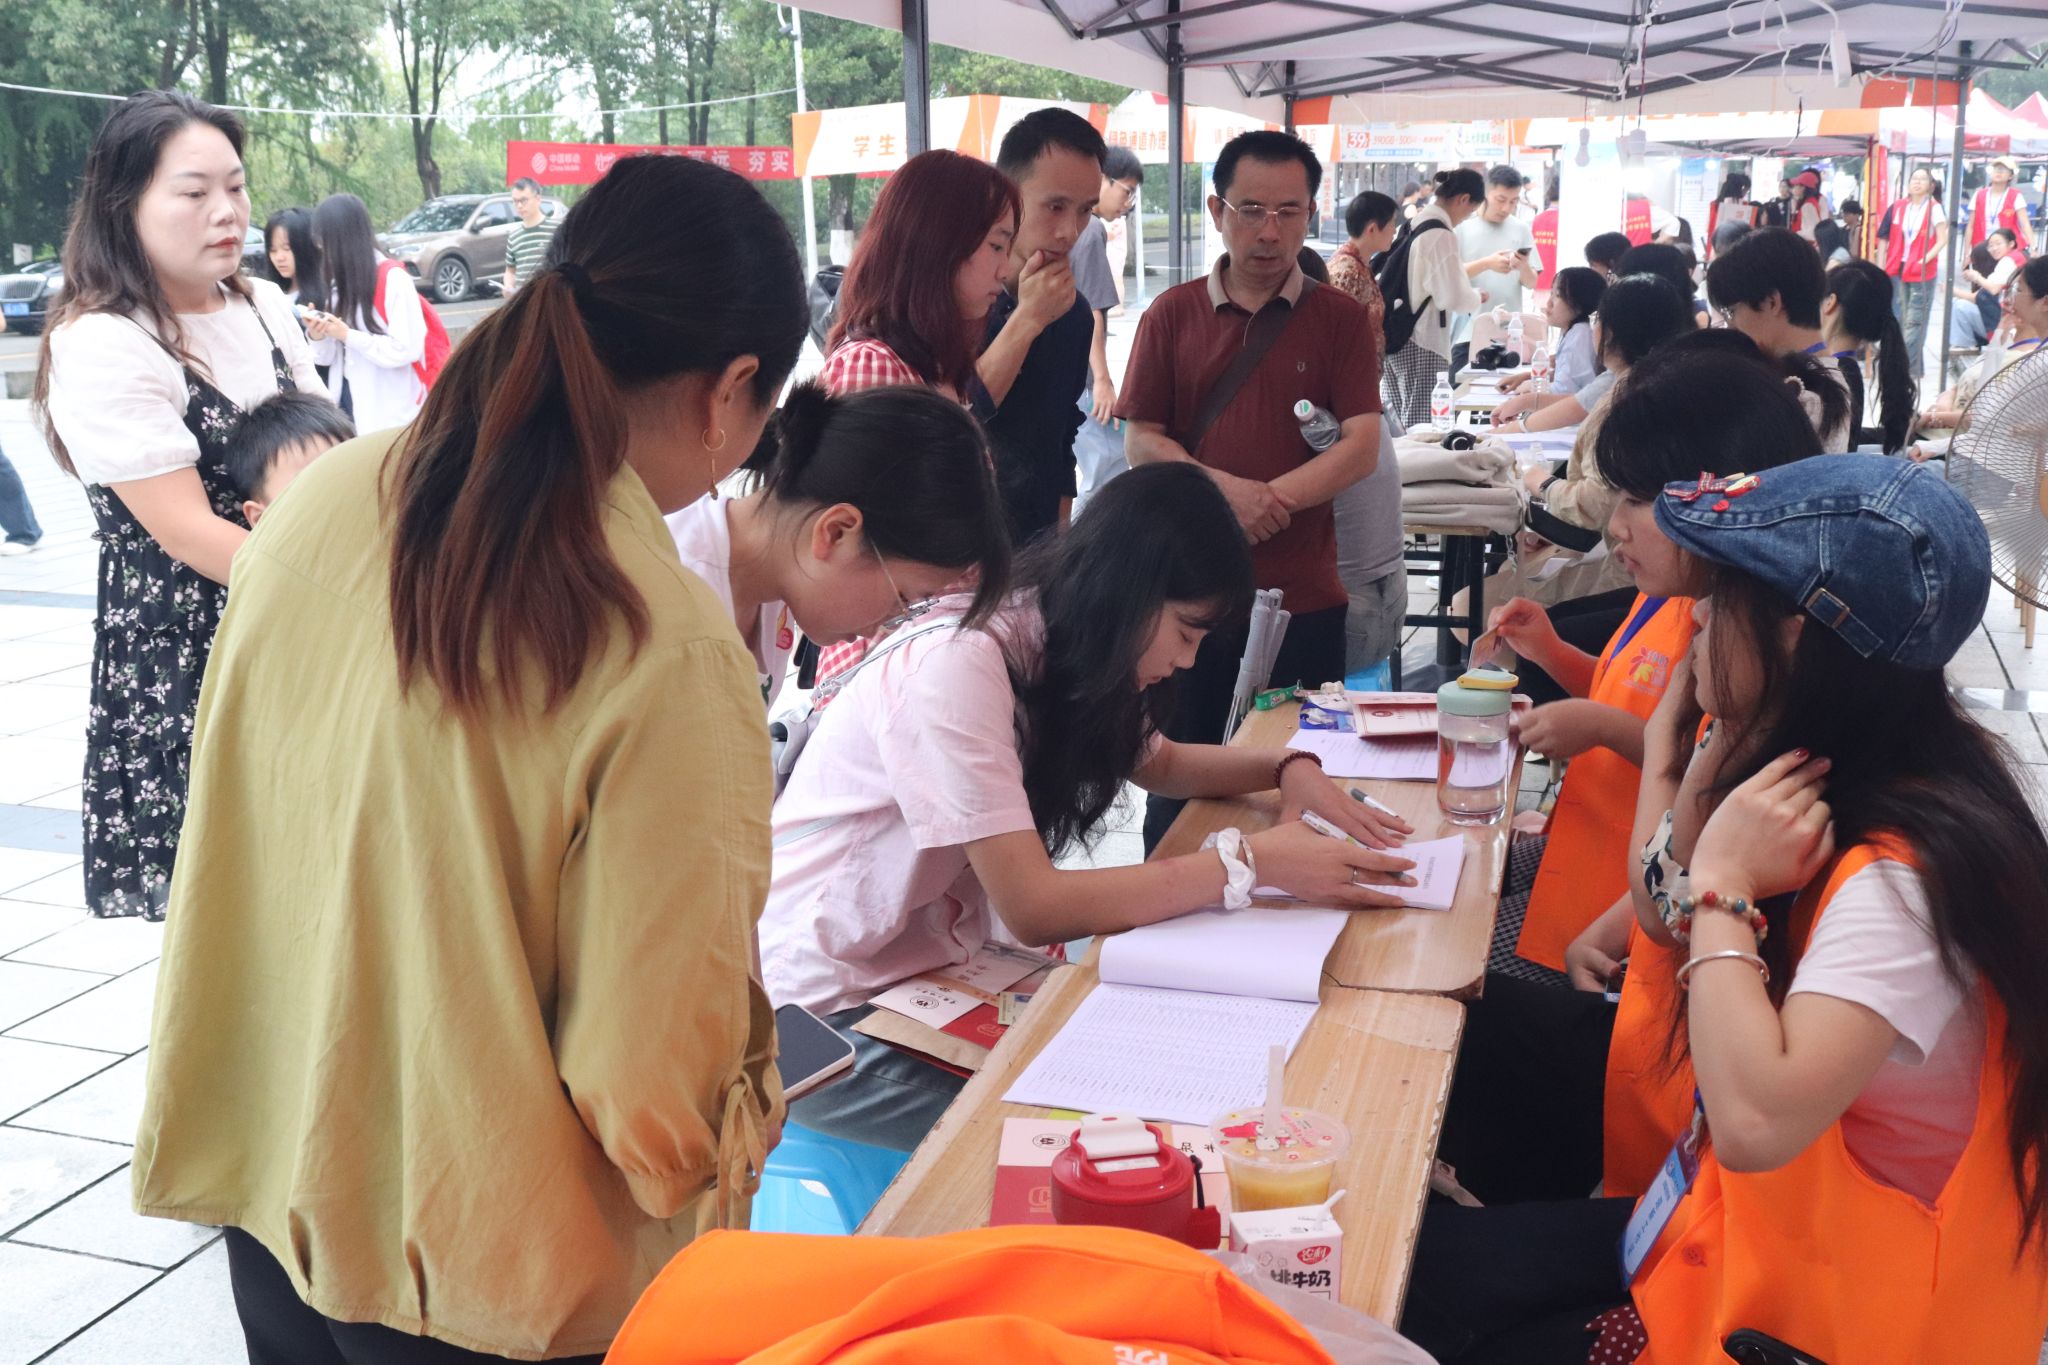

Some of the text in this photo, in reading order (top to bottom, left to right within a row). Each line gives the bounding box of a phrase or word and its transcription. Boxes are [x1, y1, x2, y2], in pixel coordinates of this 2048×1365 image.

[853, 133, 908, 158] 学生
[549, 153, 581, 164] 中国移动
